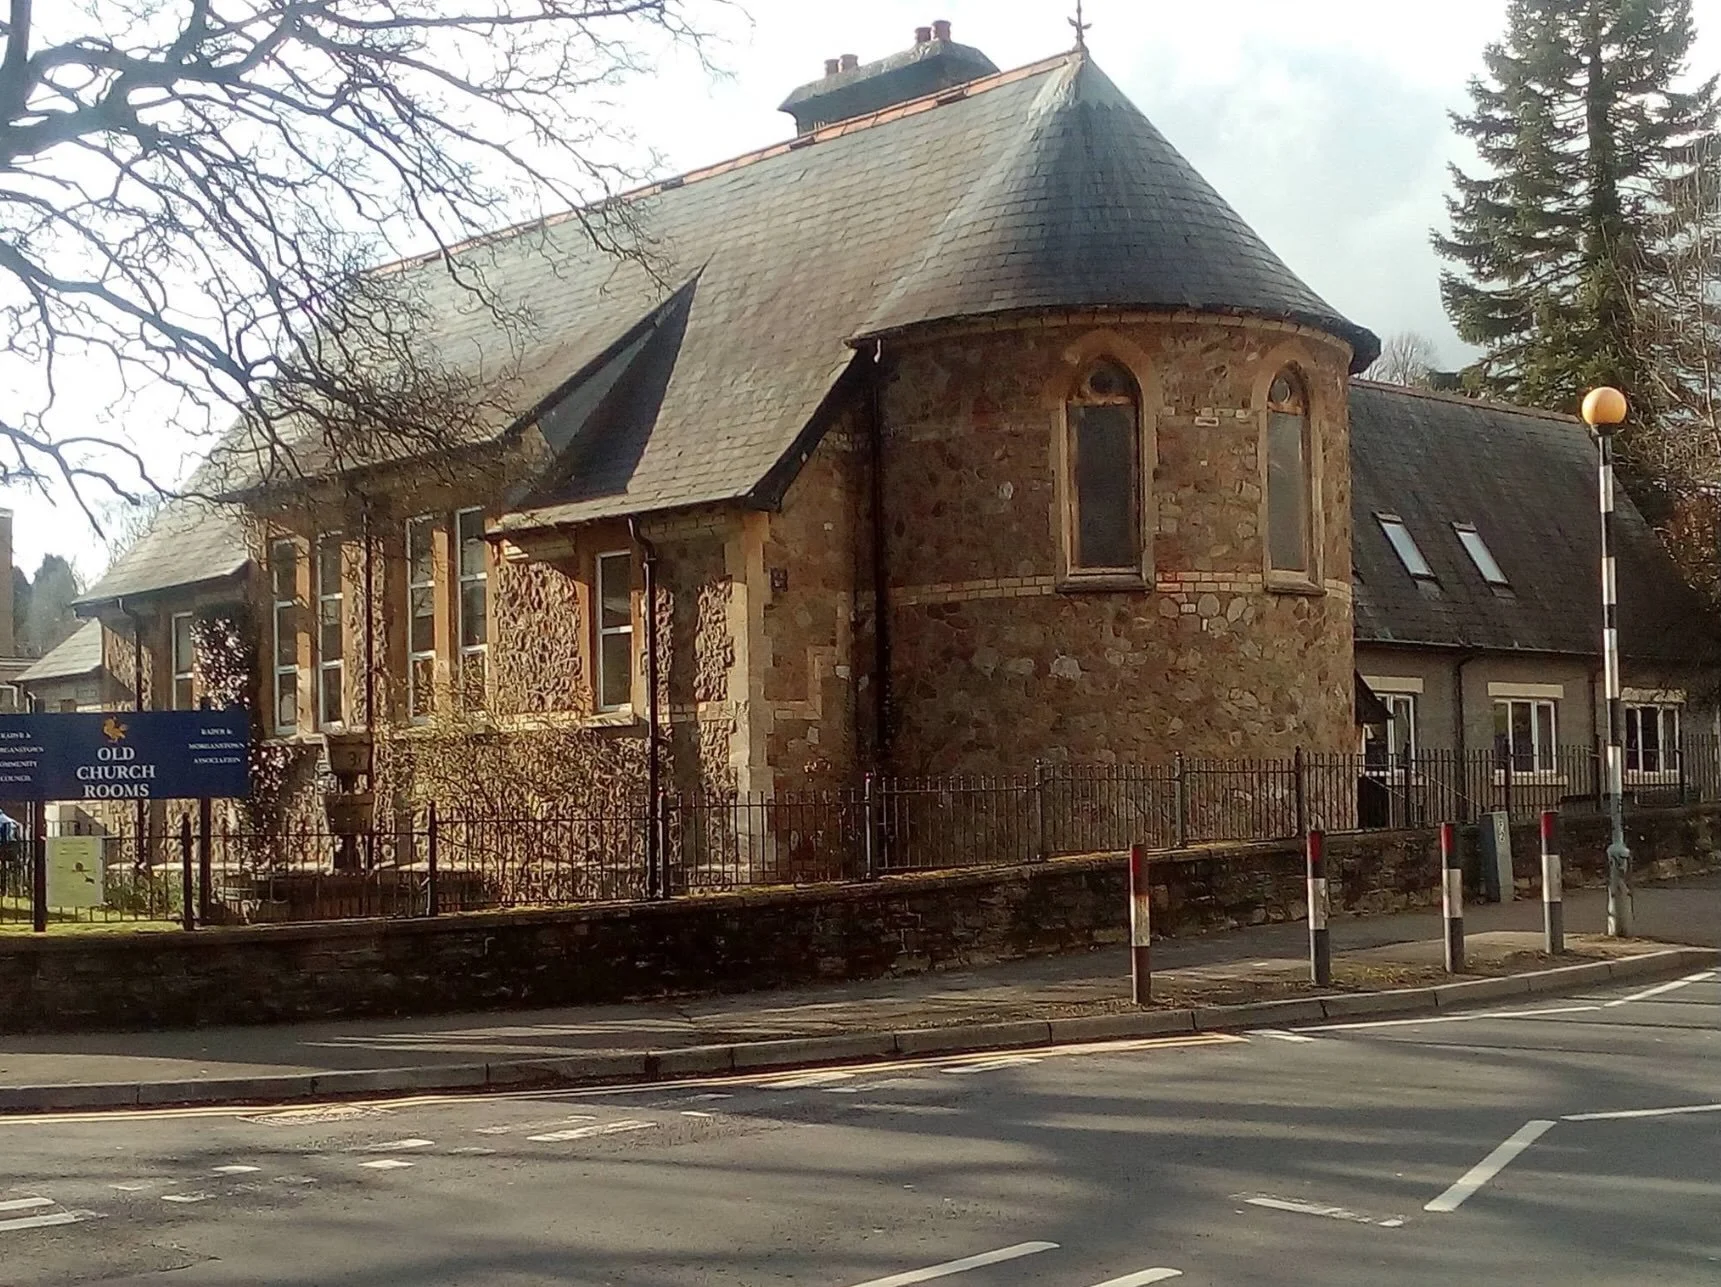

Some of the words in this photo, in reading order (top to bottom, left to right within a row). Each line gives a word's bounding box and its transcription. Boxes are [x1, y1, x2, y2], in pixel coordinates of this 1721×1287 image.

[97, 747, 135, 761] OLD
[0, 760, 37, 768] OMMUNITY
[76, 765, 156, 780] CHURCH
[82, 783, 150, 798] ROOMS
